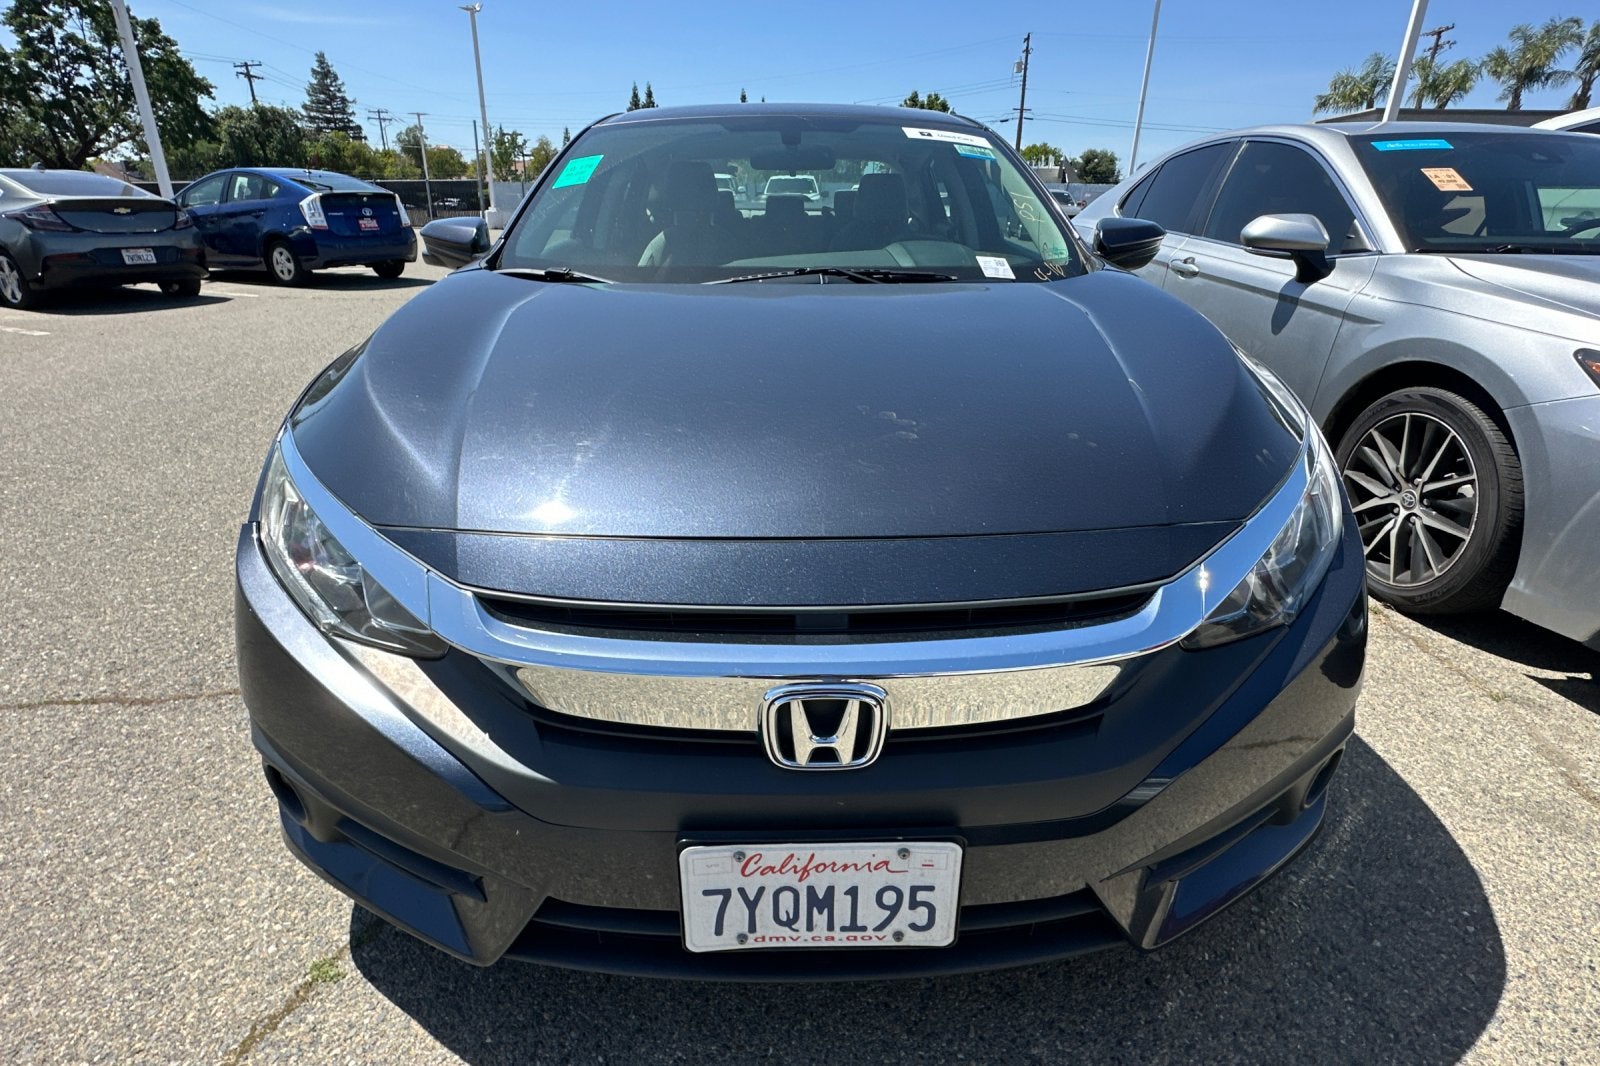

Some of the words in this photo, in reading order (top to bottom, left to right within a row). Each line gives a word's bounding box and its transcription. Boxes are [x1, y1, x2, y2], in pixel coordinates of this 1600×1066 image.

[740, 853, 908, 882] California
[702, 885, 937, 936] 7YQM195
[754, 934, 887, 943] dmv.ca.gov
